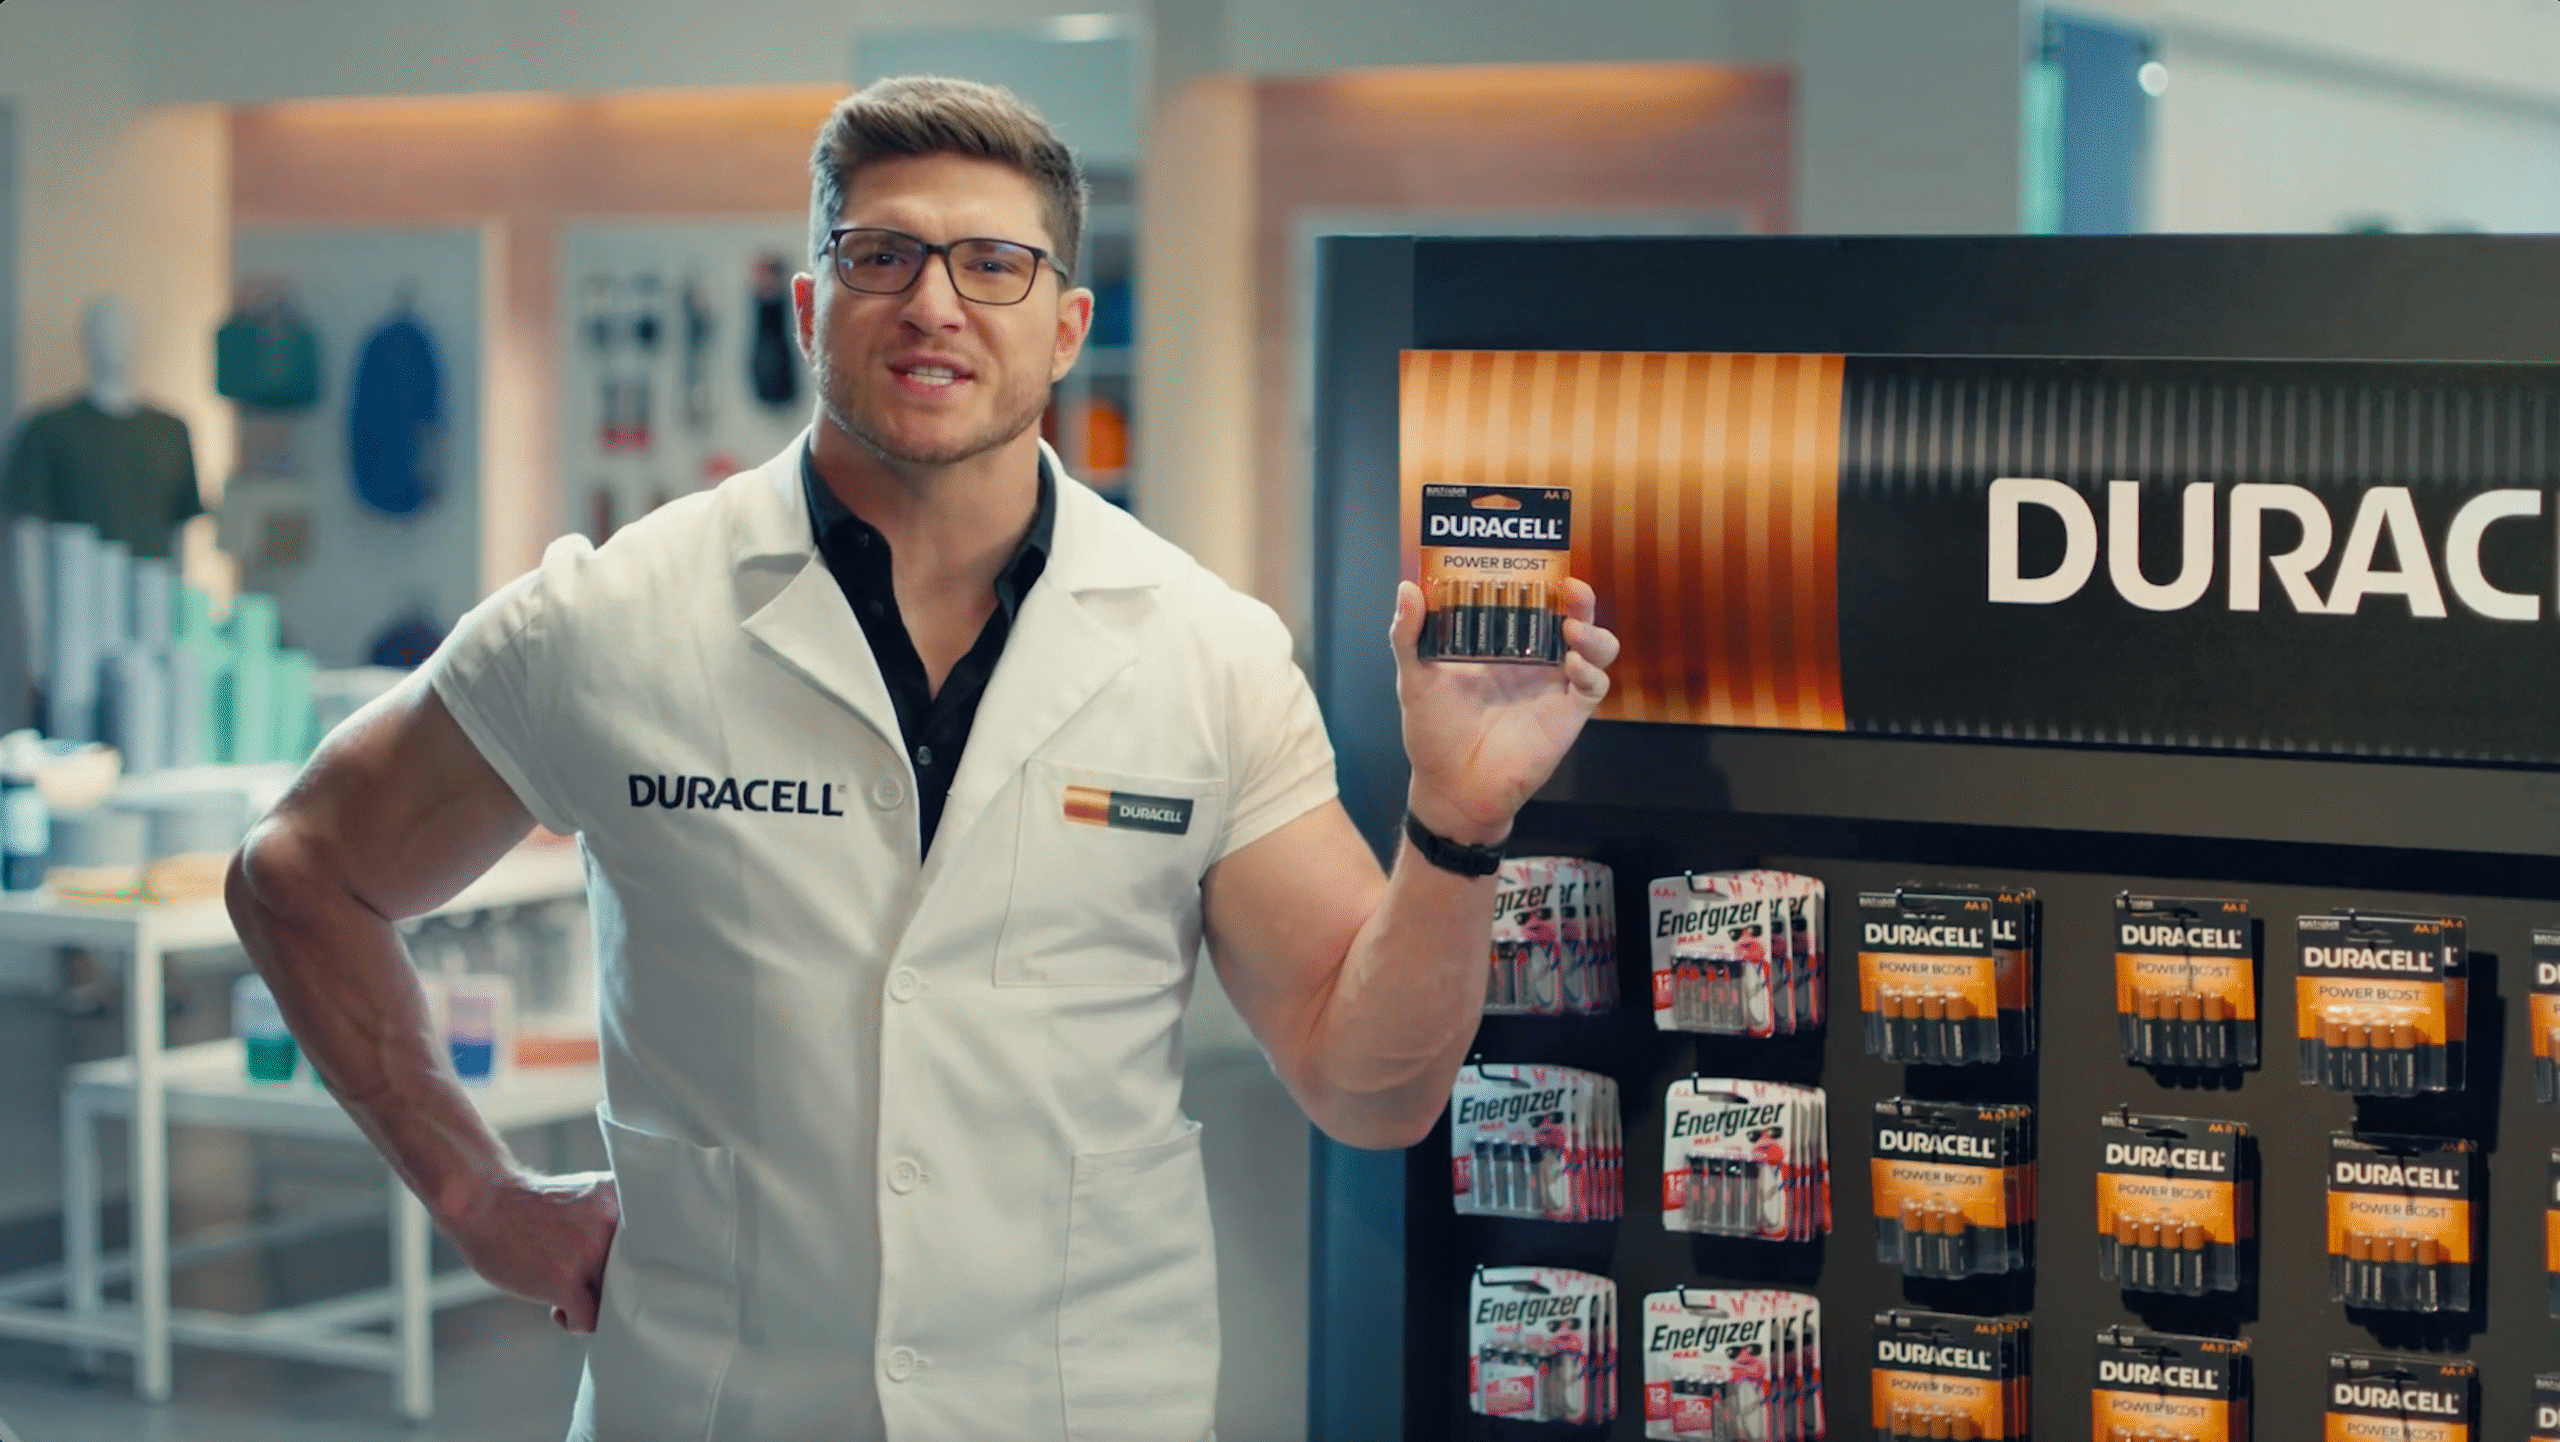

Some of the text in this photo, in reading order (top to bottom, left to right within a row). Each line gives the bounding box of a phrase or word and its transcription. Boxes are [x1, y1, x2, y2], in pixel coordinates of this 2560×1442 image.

[1430, 514, 1562, 540] DURACELL
[1443, 555, 1549, 571] POWER BOOST
[1988, 477, 2560, 621] DURAC
[628, 774, 844, 817] DURACELL
[1120, 805, 1182, 824] DURACELL
[1494, 883, 1553, 921] gizer
[1656, 900, 1763, 938] Energizer
[1865, 922, 1984, 948] DURACELL
[2121, 924, 2242, 950] DURACELL
[1879, 961, 1929, 974] POWER
[2136, 962, 2188, 976] POWER
[2304, 946, 2434, 973] DURACELL
[2319, 985, 2422, 1002] POWER BOOST
[1458, 1088, 1566, 1125] Energizer
[1672, 1103, 1785, 1138] Energizer
[1879, 1129, 1996, 1160] DURACELL
[2105, 1143, 2225, 1173] DURACELL
[1891, 1168, 1941, 1182] POWER
[2117, 1182, 2170, 1197] POWER
[2335, 1162, 2460, 1191] DURACELL
[2350, 1200, 2402, 1215] POWER
[1476, 1295, 1585, 1327] Energizer
[1651, 1319, 1766, 1353] Energizer
[1878, 1340, 1992, 1372] DURACELL
[2100, 1360, 2219, 1391] DURACELL
[2334, 1383, 2459, 1415] DURACELL
[2347, 1422, 2400, 1438] POWER
